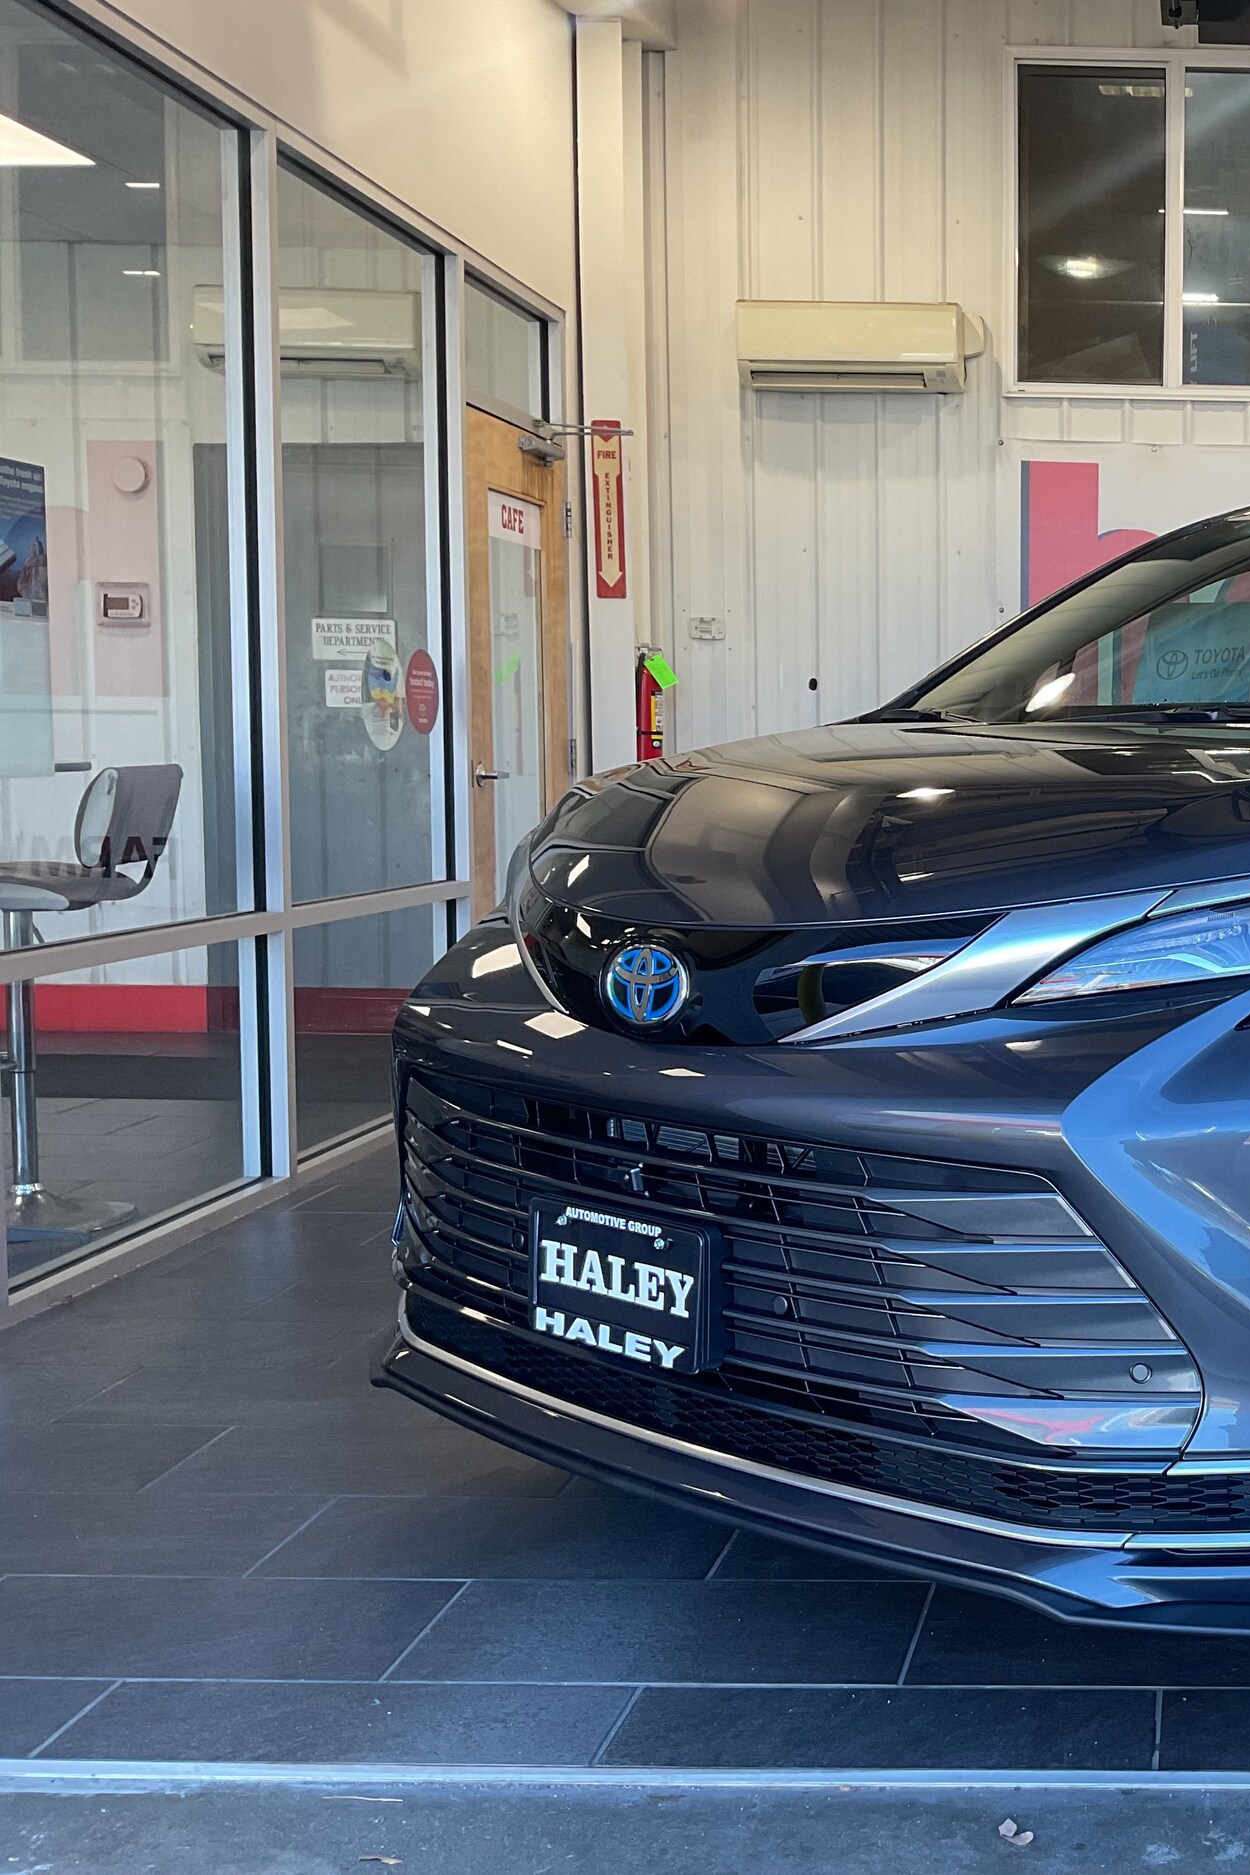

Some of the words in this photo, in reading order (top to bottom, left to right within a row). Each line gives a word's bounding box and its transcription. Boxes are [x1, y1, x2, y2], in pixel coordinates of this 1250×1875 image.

[597, 450, 617, 459] FIRE
[501, 504, 524, 534] CAFE
[604, 472, 614, 560] EXTINGUISHER
[315, 623, 343, 634] PARTS
[345, 624, 352, 633] &
[355, 624, 392, 635] SERVICE
[323, 636, 384, 647] DEPARTMEN
[1194, 646, 1245, 665] TOYOTA
[328, 673, 362, 682] AUTHOR
[330, 684, 360, 693] PERSO
[344, 696, 362, 705] ONL
[565, 1206, 626, 1230] AUTOMOTIVE
[628, 1220, 662, 1238] GROUP
[540, 1239, 694, 1318] HALEY
[535, 1306, 686, 1369] HALEY
